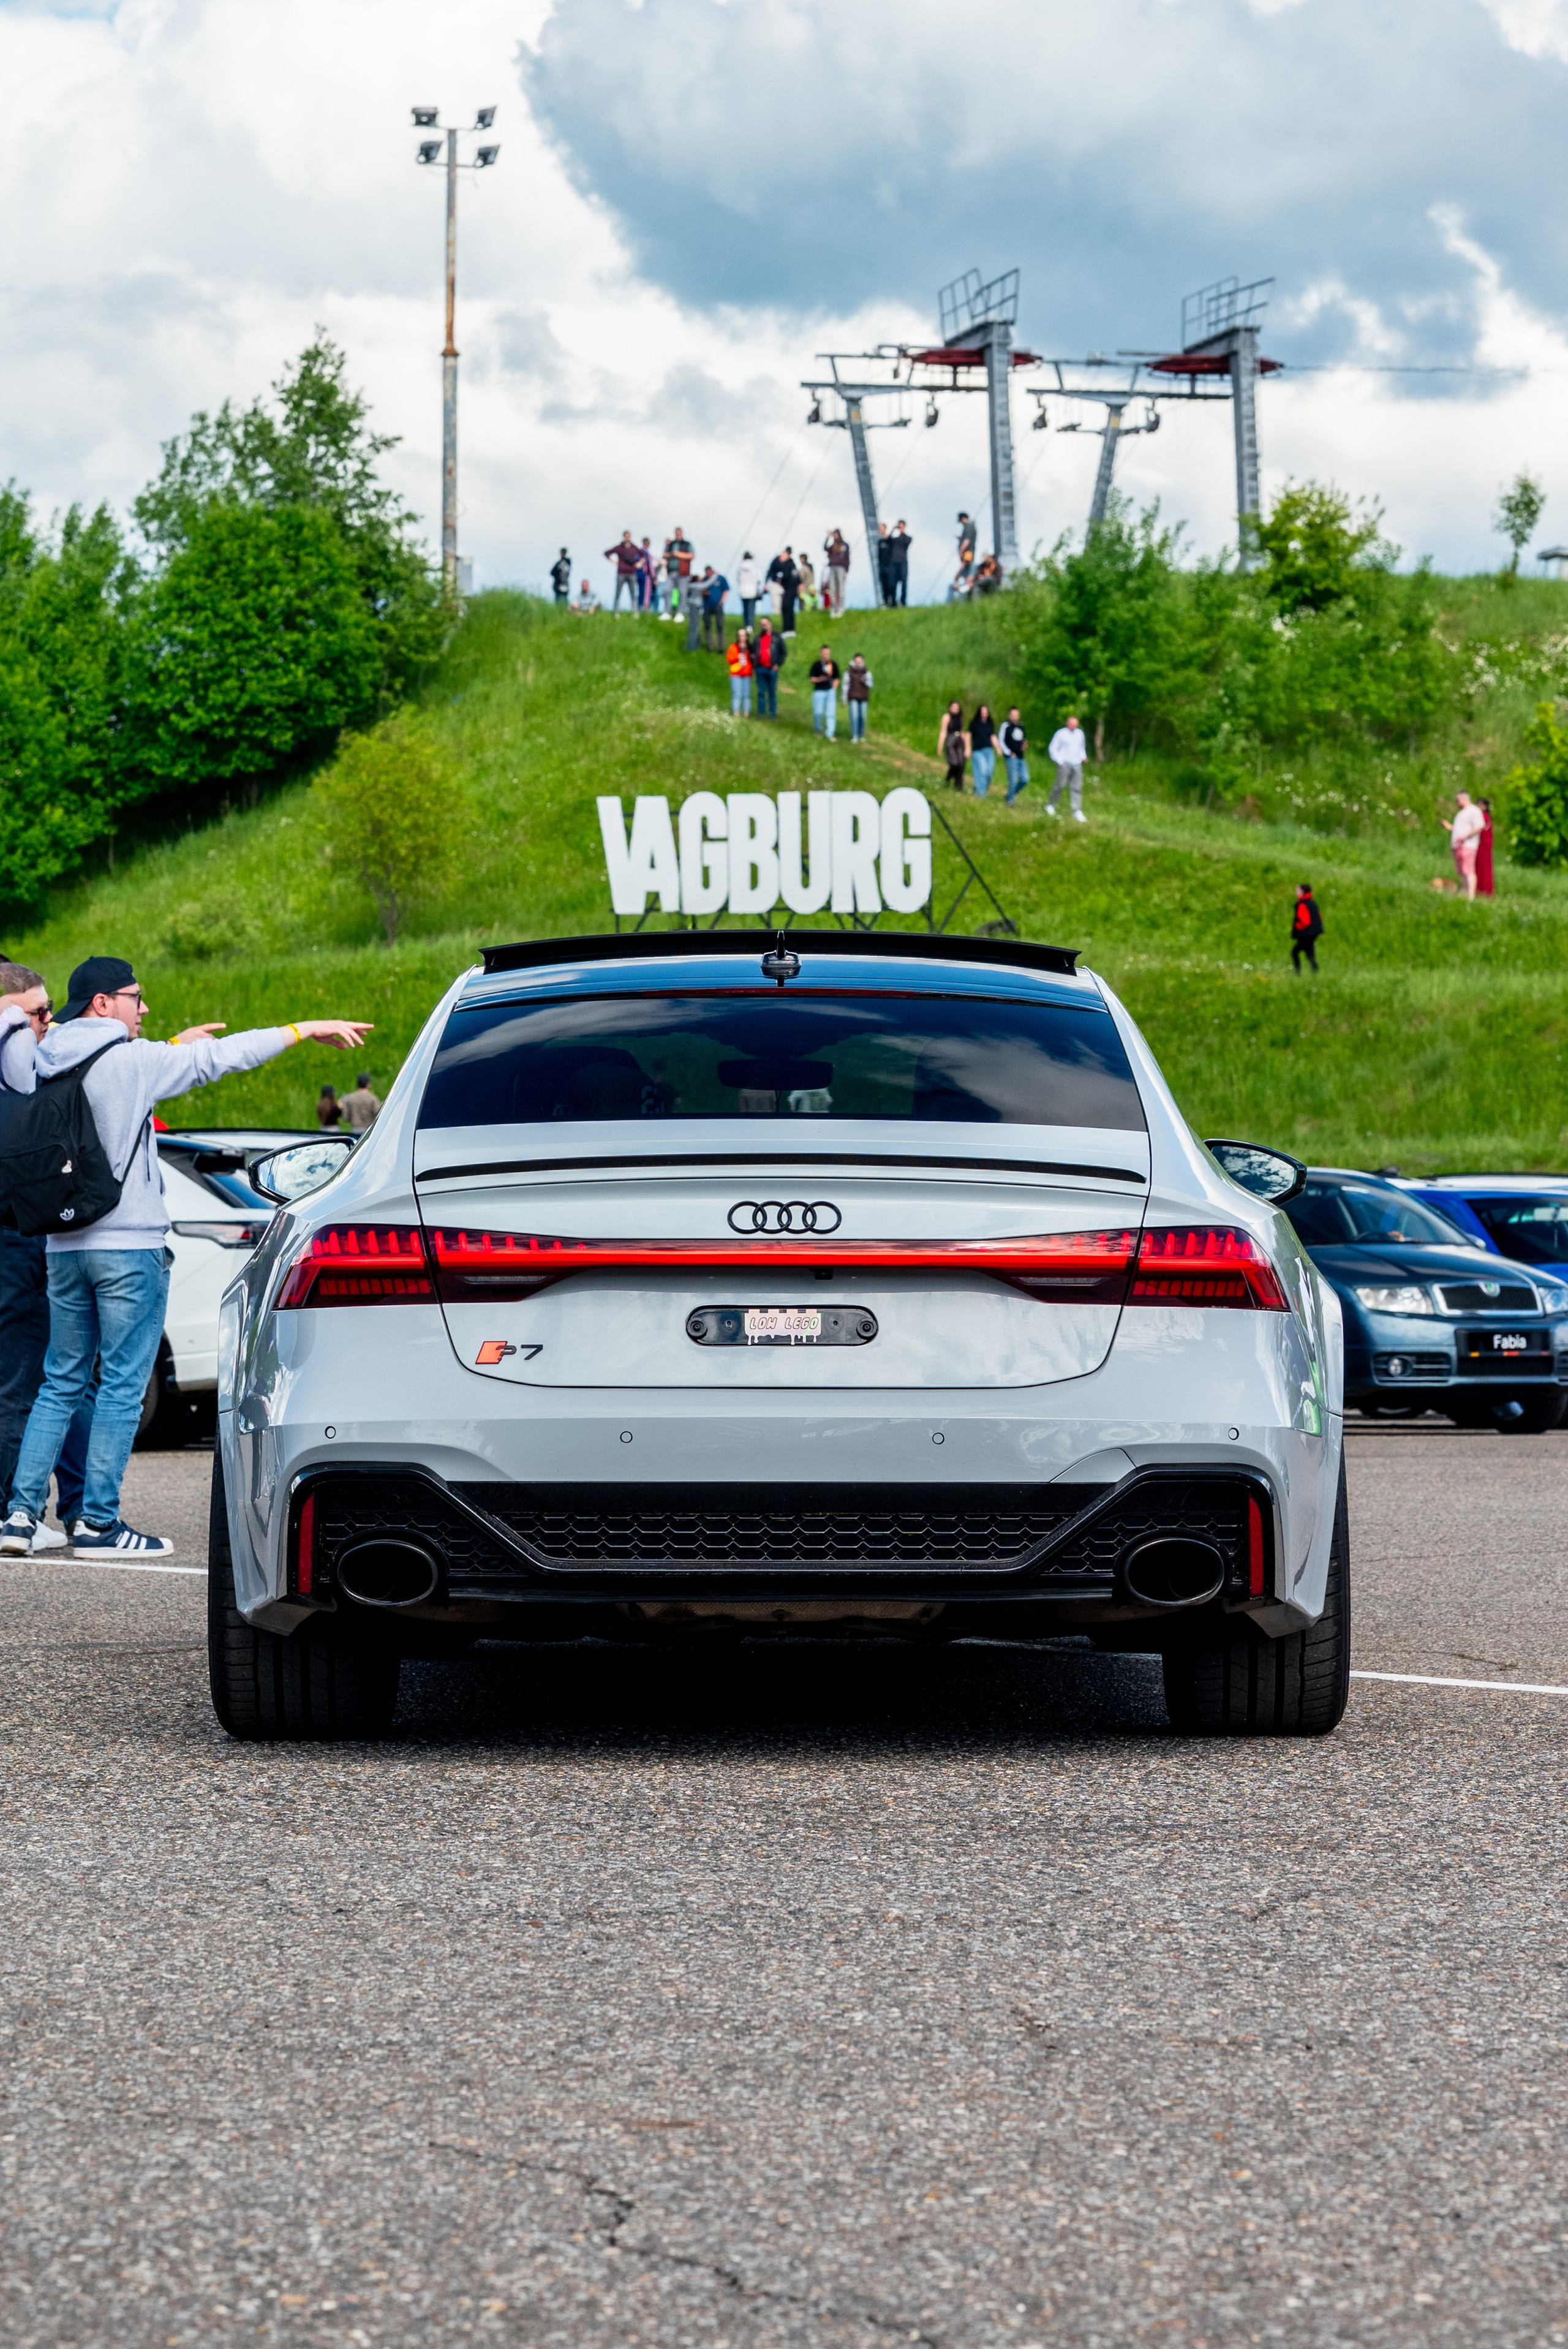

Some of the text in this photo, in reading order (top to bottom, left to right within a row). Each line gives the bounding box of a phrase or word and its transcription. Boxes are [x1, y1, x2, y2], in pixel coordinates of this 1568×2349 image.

[597, 787, 932, 915] VAGBURG
[749, 1317, 819, 1330] LOW LEGO
[1493, 1334, 1527, 1349] Fabia
